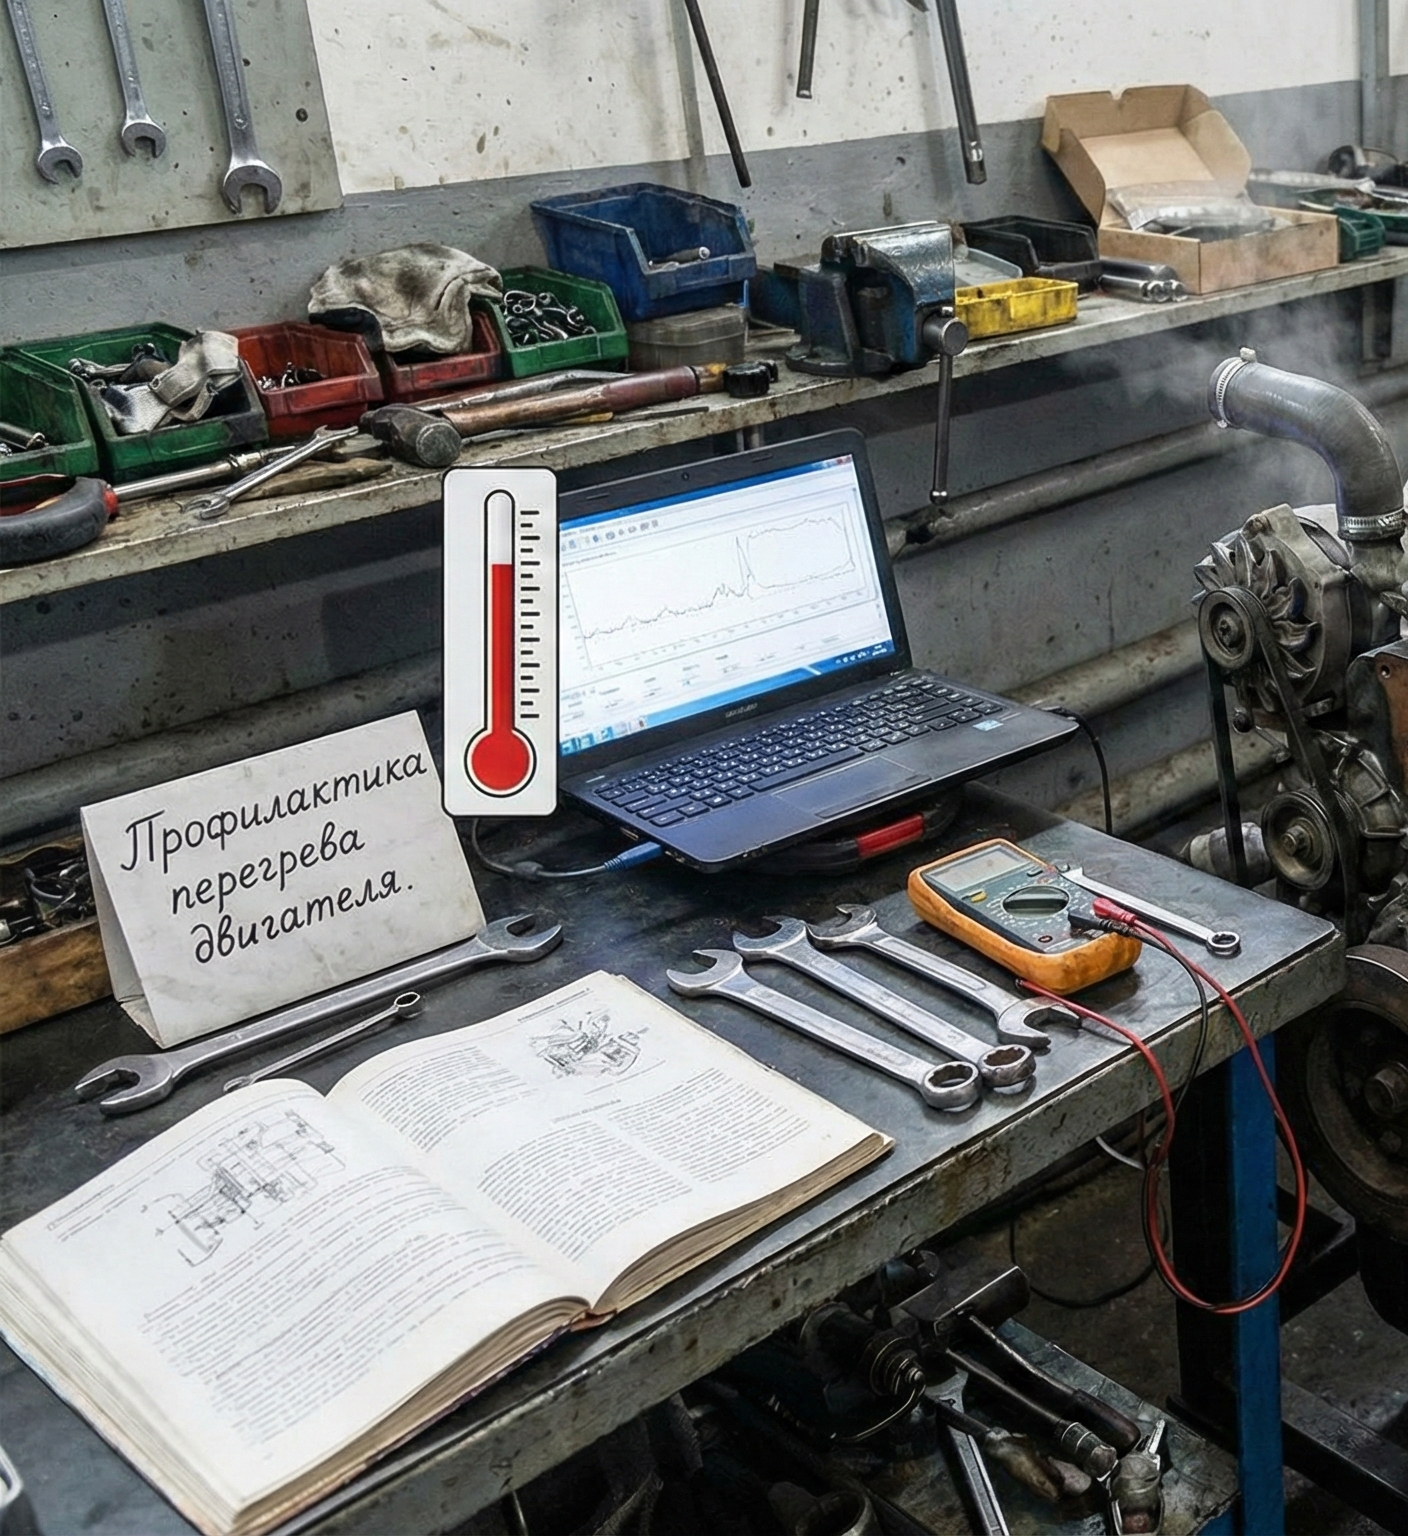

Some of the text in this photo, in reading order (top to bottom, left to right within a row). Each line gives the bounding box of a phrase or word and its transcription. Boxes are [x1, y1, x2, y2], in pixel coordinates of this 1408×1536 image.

[120, 752, 428, 874] Профилактика
[172, 821, 365, 914] перегрева
[190, 869, 414, 964] двигателя.
